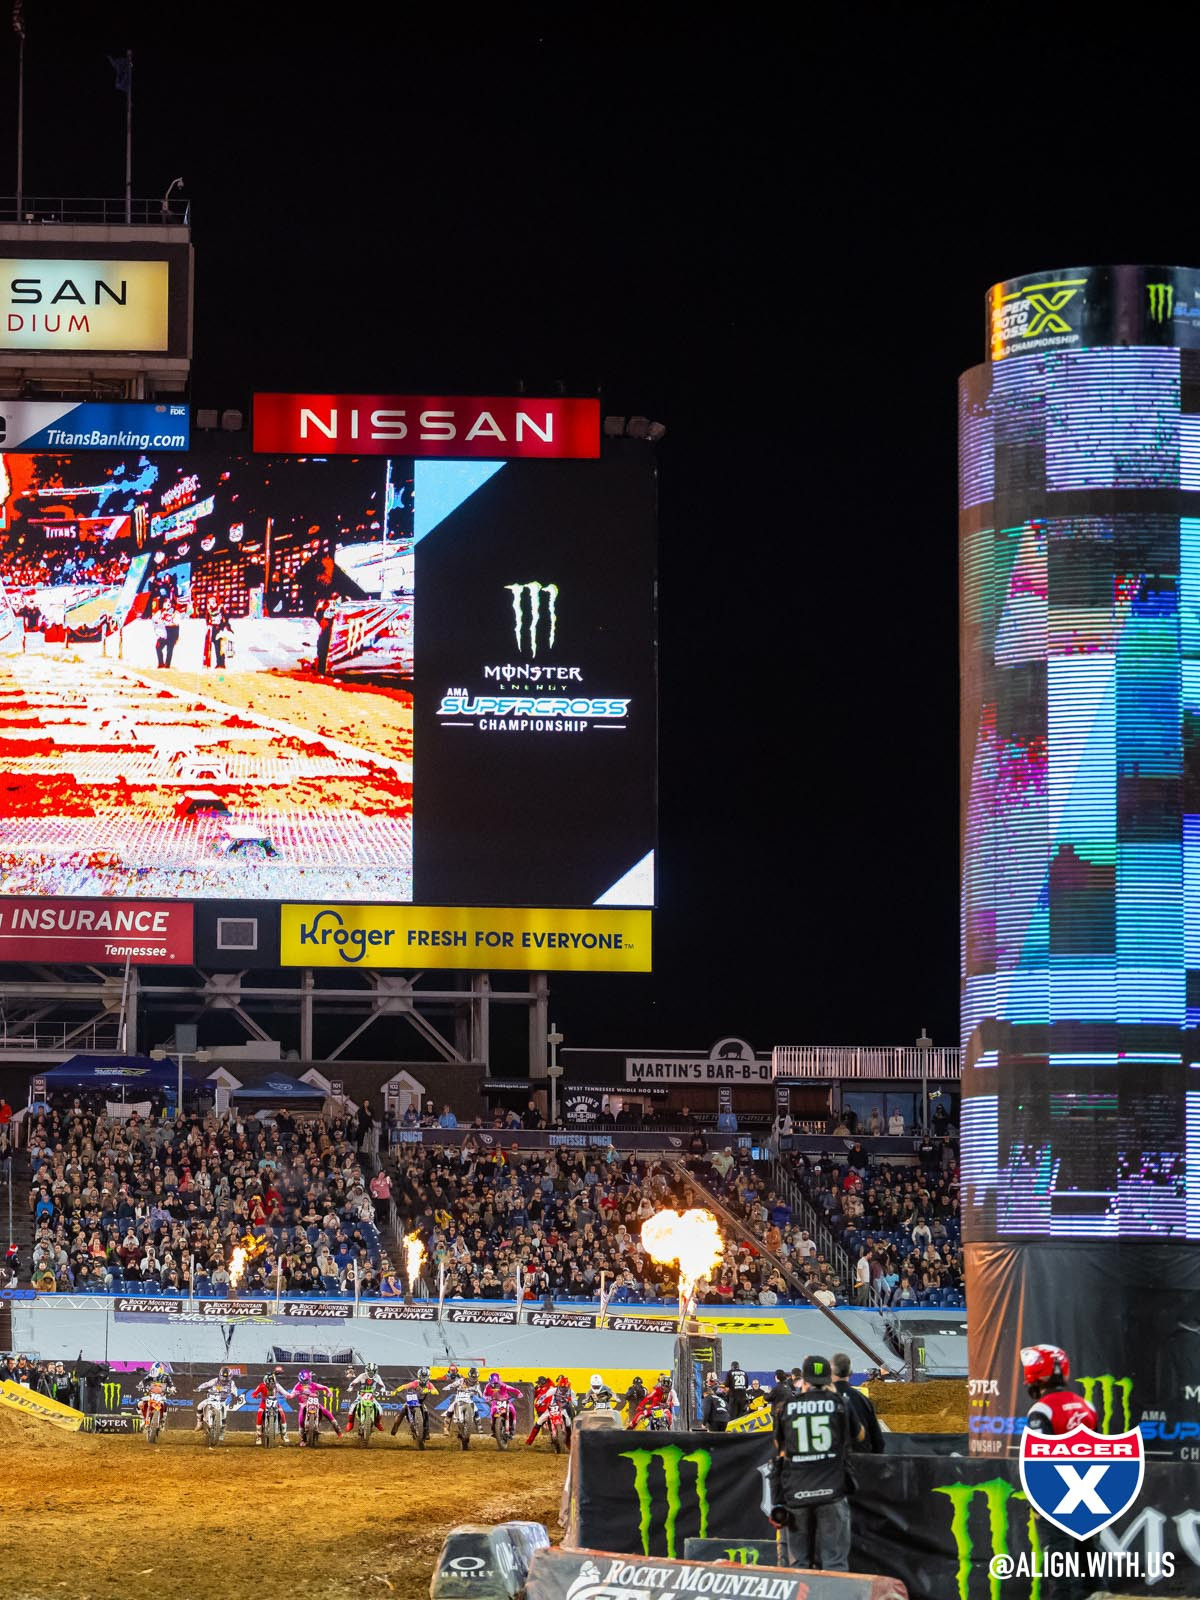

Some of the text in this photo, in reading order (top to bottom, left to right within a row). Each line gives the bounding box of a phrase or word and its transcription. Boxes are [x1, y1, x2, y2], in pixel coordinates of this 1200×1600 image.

[1011, 335, 1079, 352] CHAMPIONSHIP
[170, 408, 186, 416] FDIC
[300, 409, 553, 442] NISSAN
[47, 429, 185, 450] TitansBanking.com
[484, 664, 584, 681] MONSTER
[447, 688, 469, 696] AMA
[436, 697, 632, 717] SUPERCROSS
[479, 719, 588, 731] CHAMPIONSHIP
[11, 909, 170, 932] INSURANCE
[301, 910, 395, 962] Kroger
[408, 930, 467, 947] FRESH
[476, 931, 514, 948] FOR
[522, 932, 623, 950] EVERYONE
[104, 944, 167, 958] Tennessee
[632, 1063, 701, 1078] MARTIN'S
[565, 1095, 599, 1108] MARTIN'S
[549, 1135, 586, 1146] TENNESSEE
[482, 1310, 513, 1318] MOUNTAIN
[734, 1376, 745, 1385] 20
[6, 1391, 76, 1425] DUNLOP
[308, 1397, 319, 1405] 39
[496, 1401, 507, 1409] 34
[787, 1400, 835, 1415] PHOTO
[1141, 1410, 1167, 1421] AMA
[792, 1415, 833, 1453] 15
[441, 1569, 495, 1578] OAKLEY
[602, 1558, 798, 1600] ROCKY MOUNTAIN
